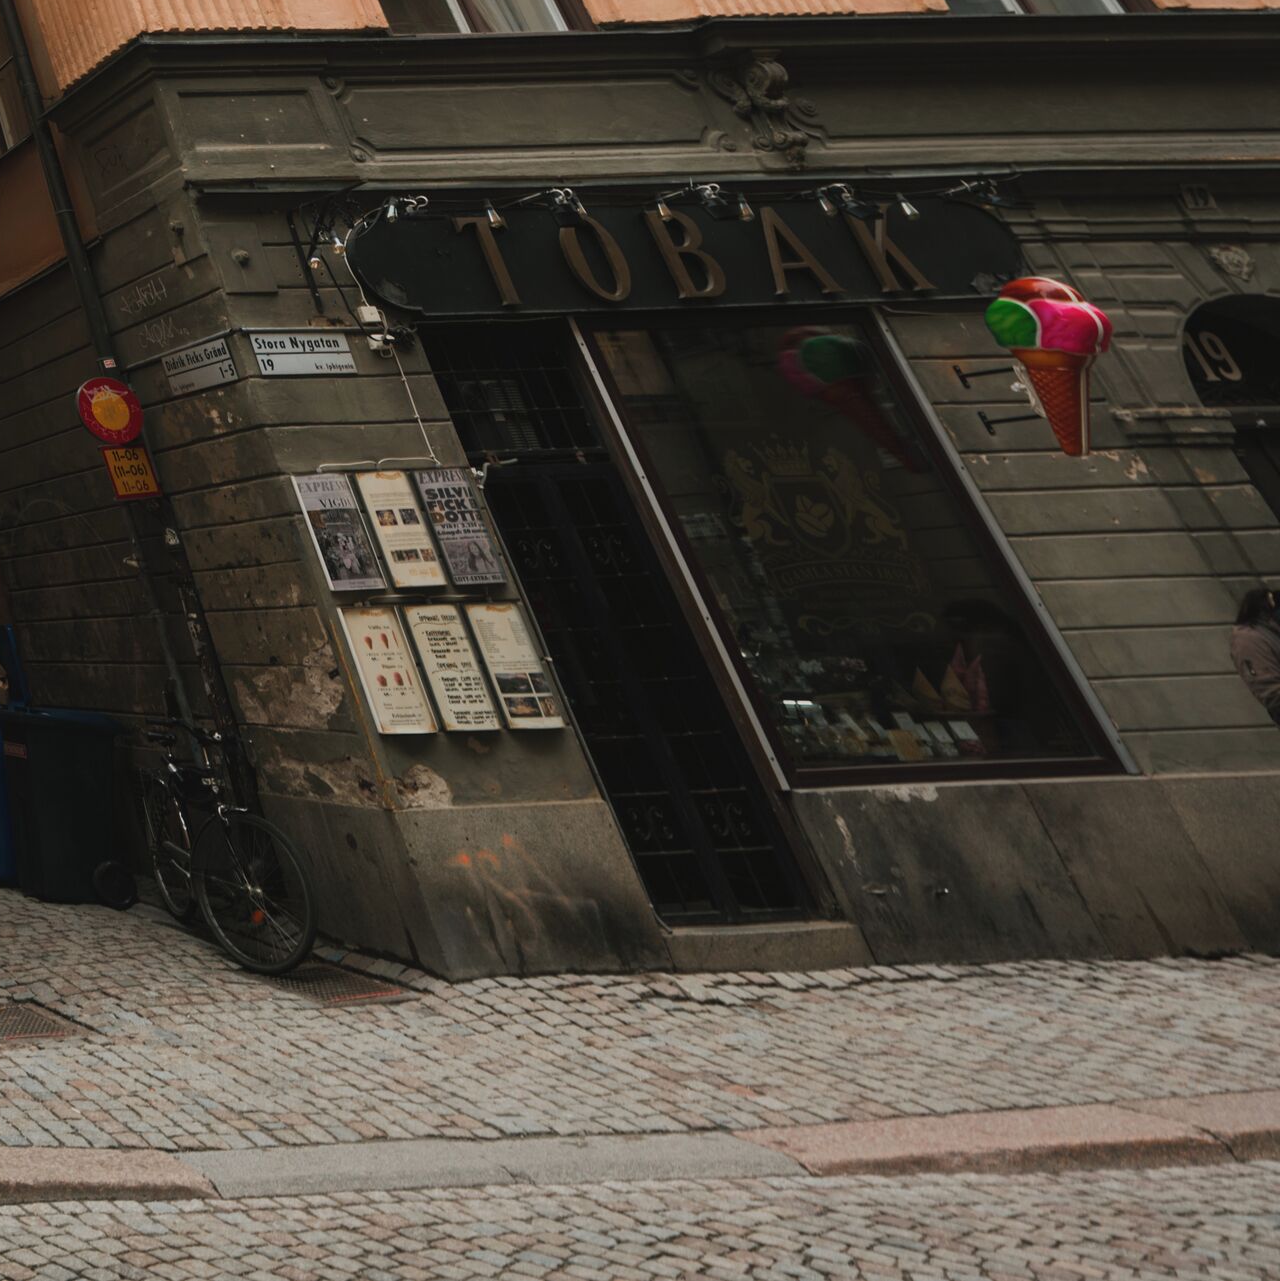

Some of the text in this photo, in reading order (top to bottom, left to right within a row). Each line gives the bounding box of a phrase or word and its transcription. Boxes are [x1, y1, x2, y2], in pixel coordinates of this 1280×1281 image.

[451, 202, 939, 307] TOBAK
[254, 336, 340, 352] Stora Nygatan
[165, 345, 227, 372] Didrik Ficks Gränd
[1183, 331, 1242, 381] 19
[219, 363, 235, 379] 1-5
[261, 358, 274, 371] 19
[112, 450, 139, 462] 11-06
[114, 462, 148, 479] (11-06)
[122, 481, 150, 493] 11-06
